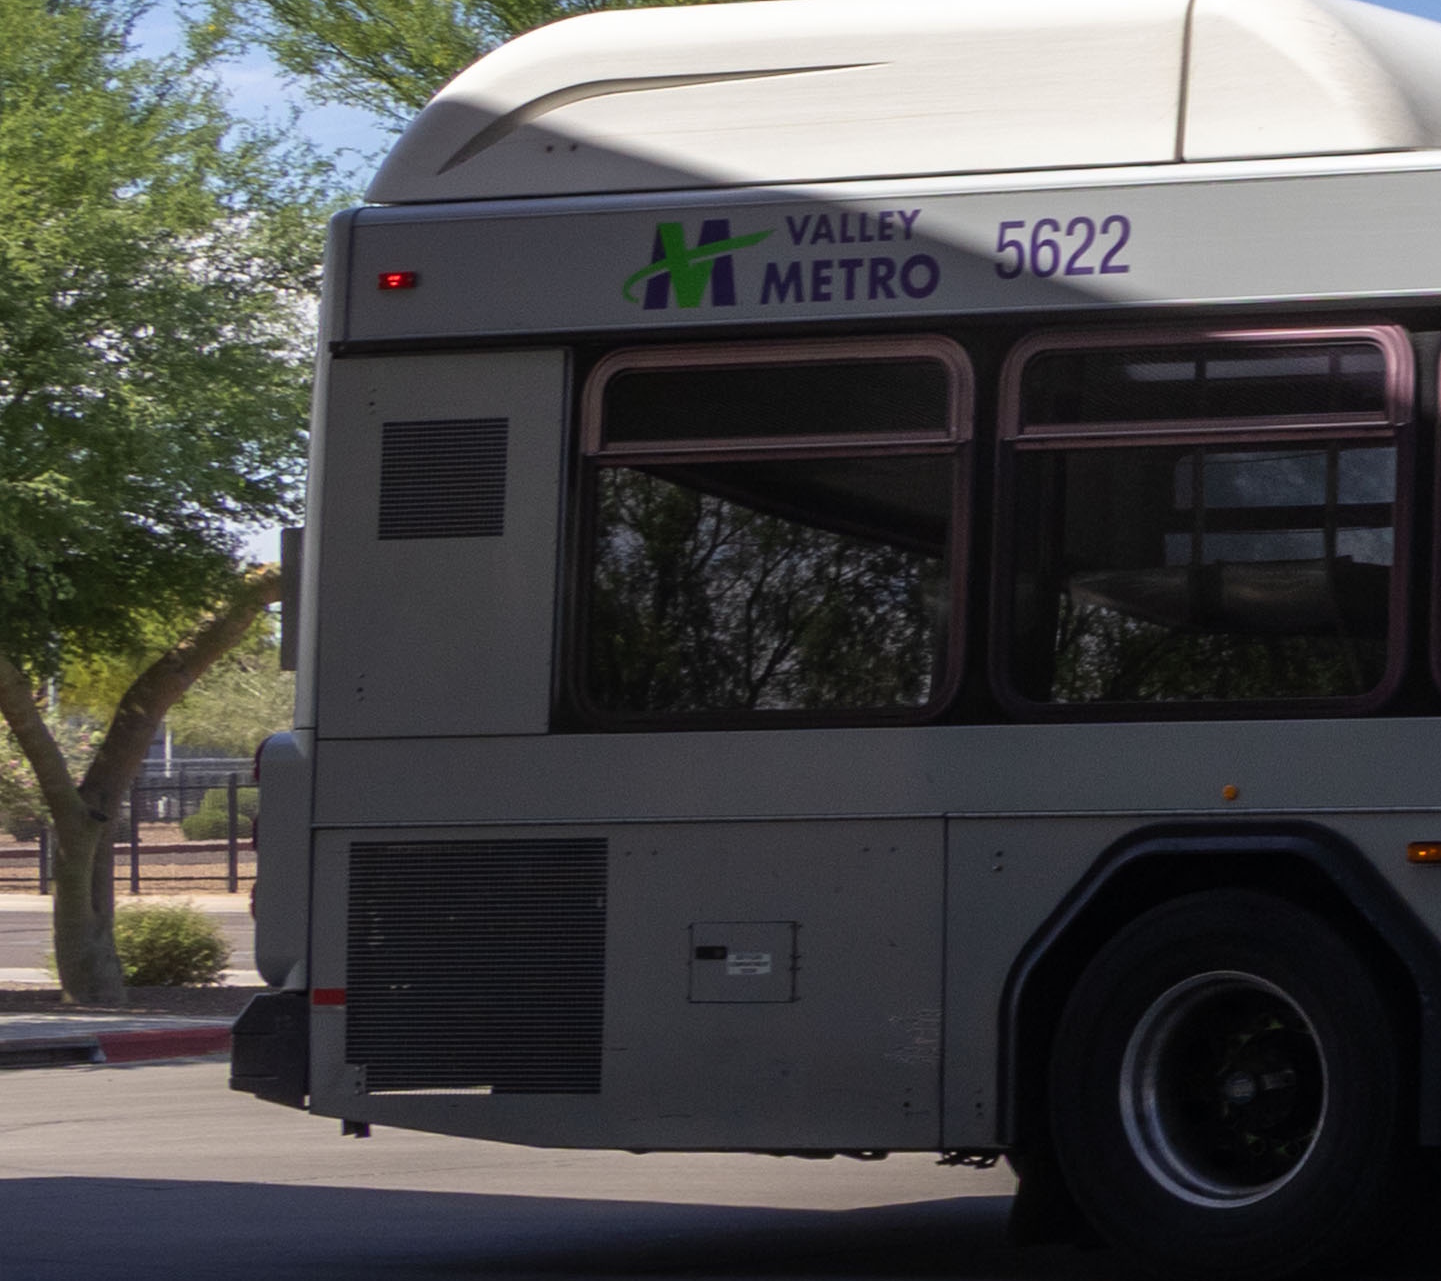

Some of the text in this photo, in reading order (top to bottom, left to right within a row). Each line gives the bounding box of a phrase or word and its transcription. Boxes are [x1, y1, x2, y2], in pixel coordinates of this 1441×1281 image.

[785, 208, 922, 246] VALLEY
[993, 214, 1133, 280] 5622
[759, 252, 941, 305] METRO
